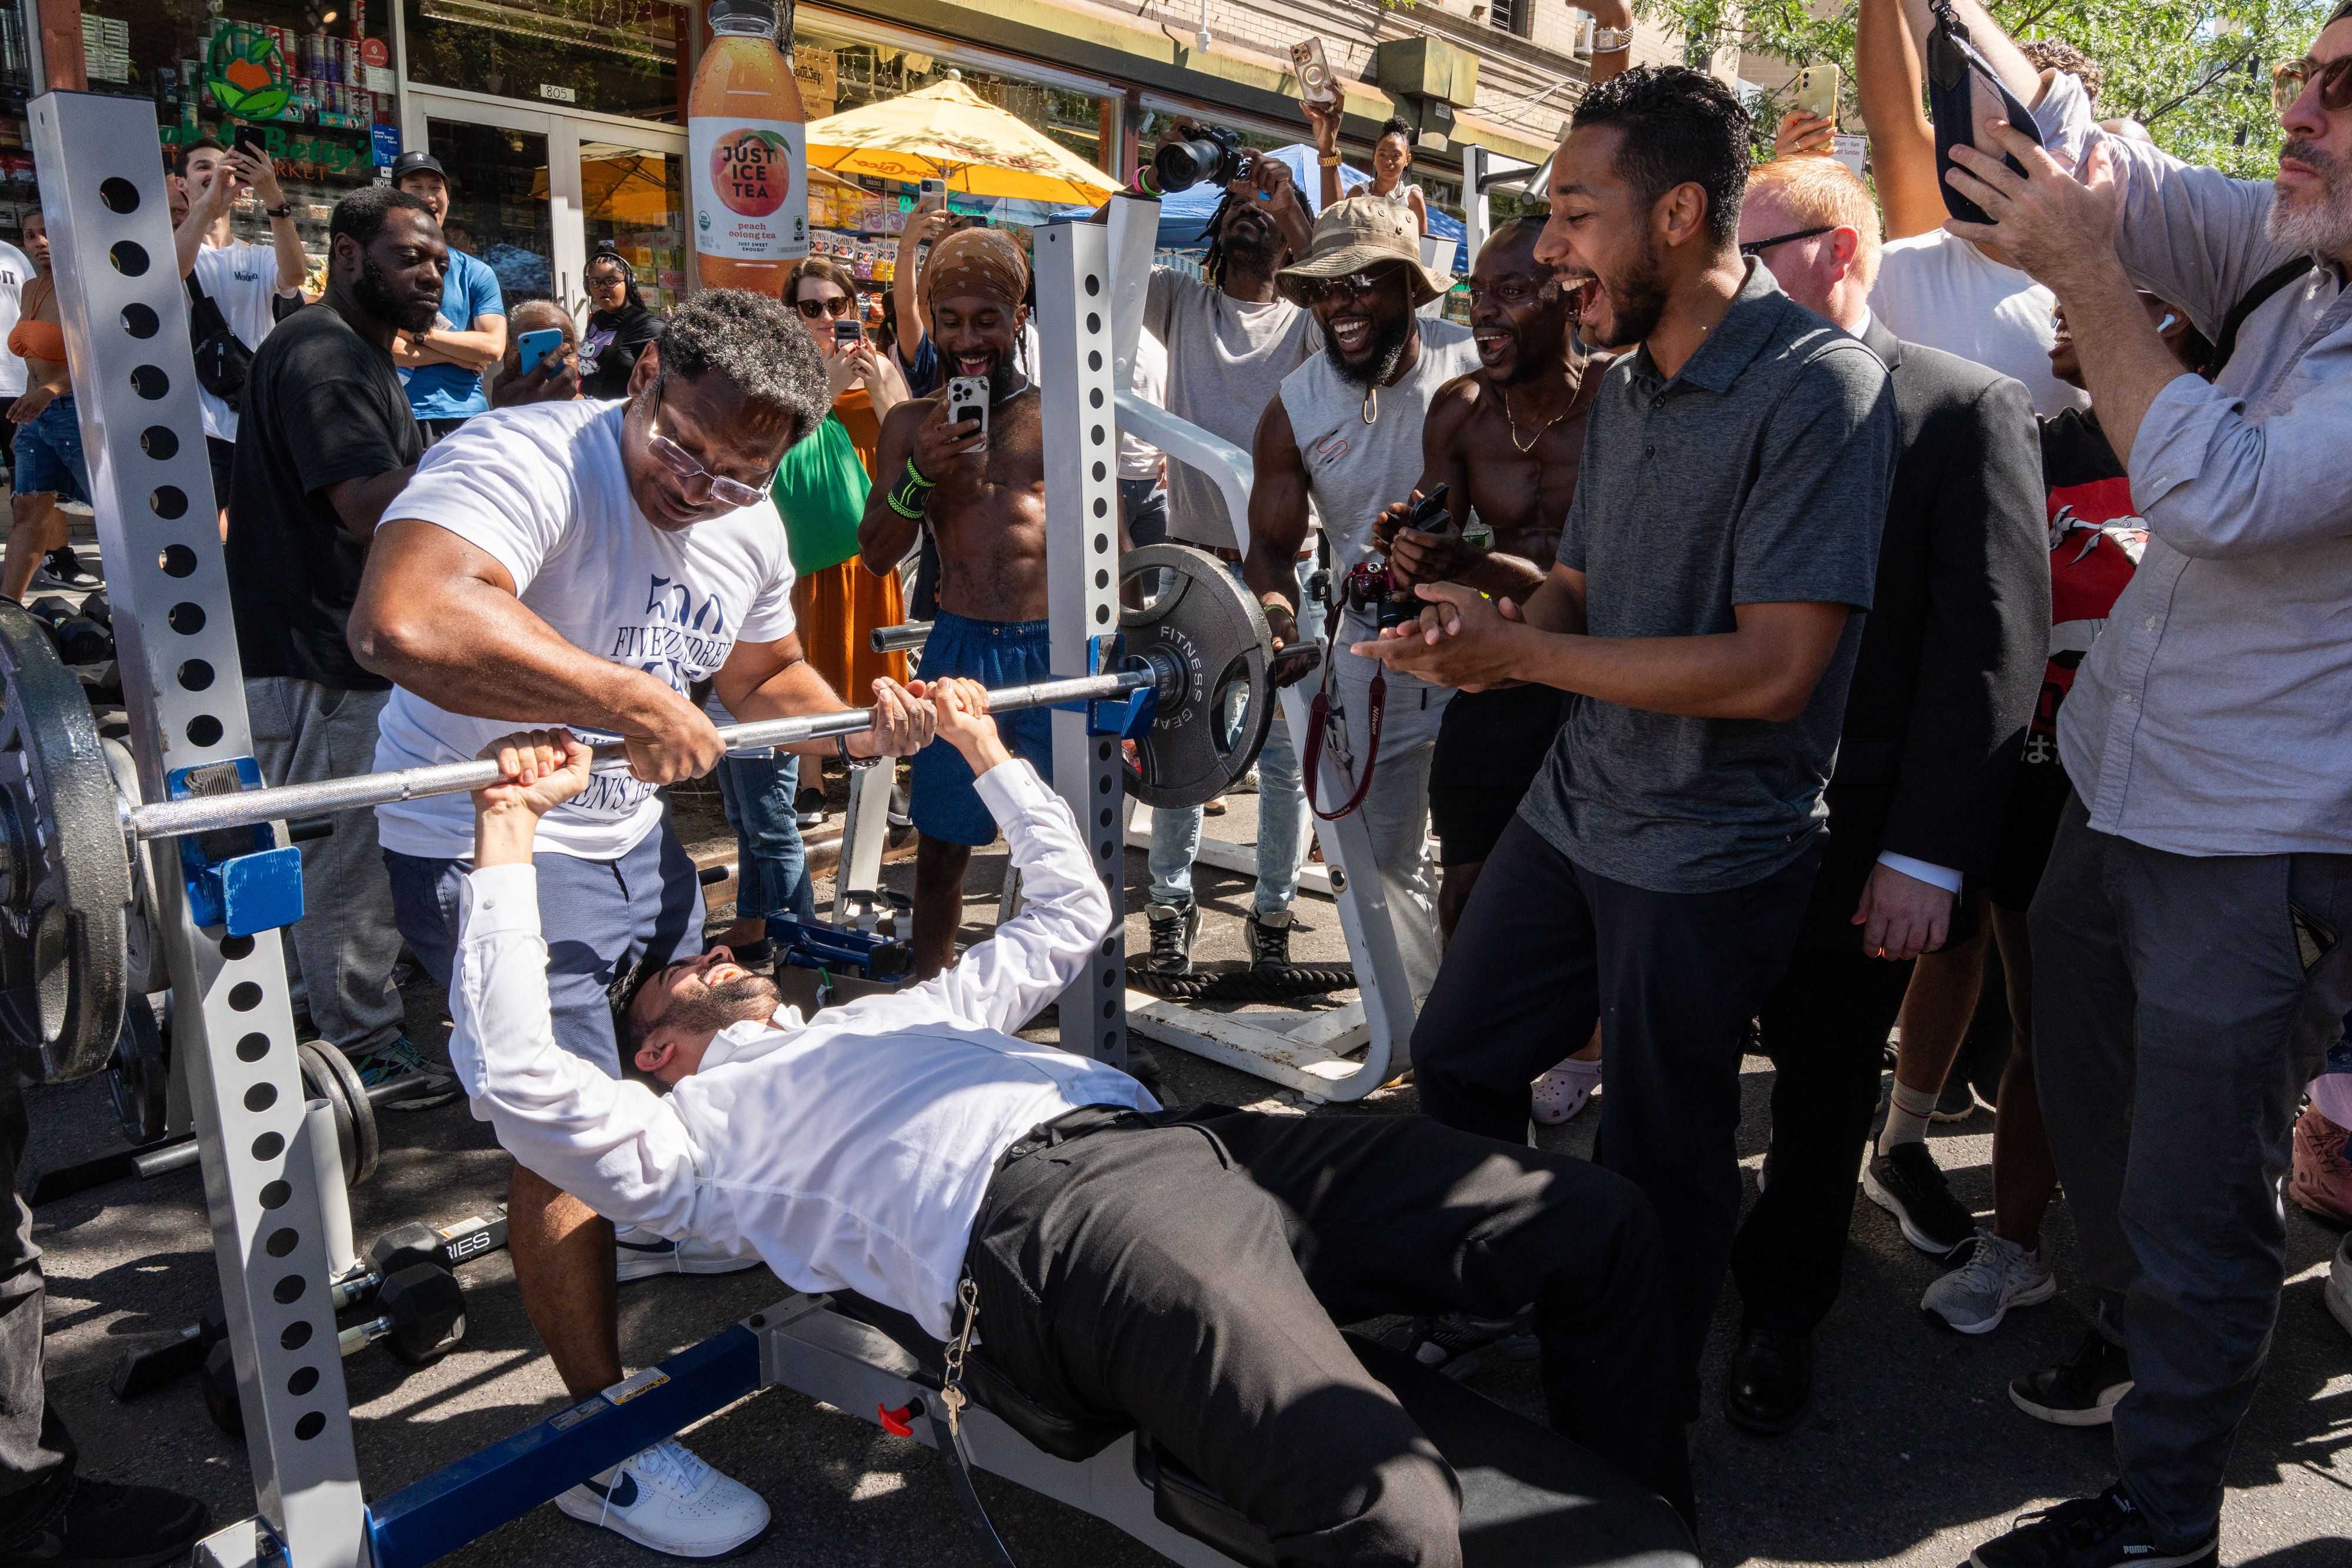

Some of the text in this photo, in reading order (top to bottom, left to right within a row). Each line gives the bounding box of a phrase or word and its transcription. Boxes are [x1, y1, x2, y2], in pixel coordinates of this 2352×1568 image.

[794, 68, 823, 85] OULDER
[547, 86, 567, 99] 805
[1212, 131, 1224, 140] SONY
[159, 119, 203, 146] ob
[262, 126, 375, 172] Betty's
[274, 160, 327, 181] RKET
[732, 164, 767, 181] ICE
[375, 179, 385, 188] NO
[731, 183, 769, 198] TEA
[729, 230, 760, 240] oolong
[833, 244, 853, 256] POP
[234, 271, 258, 282] Modeo
[1161, 626, 1204, 702] FITNESS
[568, 773, 632, 810] EN'S
[1325, 805, 1351, 818] Nikon
[447, 1232, 490, 1259] RIES
[2123, 1545, 2148, 1554] PUMA
